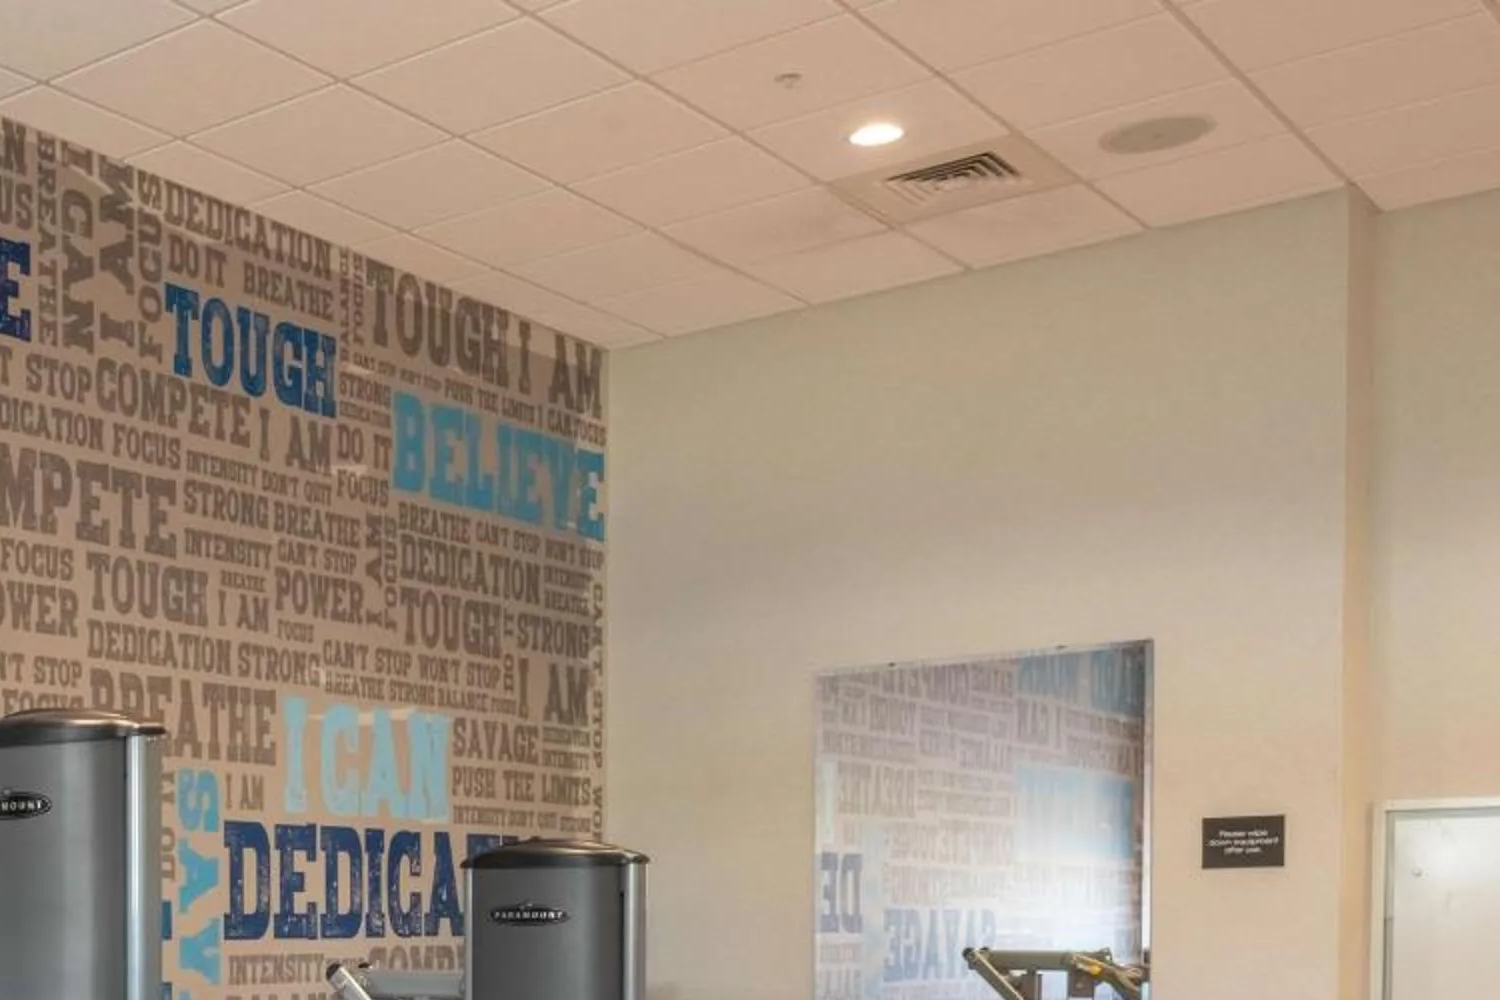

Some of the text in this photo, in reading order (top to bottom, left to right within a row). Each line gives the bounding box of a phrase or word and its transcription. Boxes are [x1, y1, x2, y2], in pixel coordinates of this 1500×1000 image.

[99, 153, 135, 295] AM
[163, 179, 333, 282] DEDICATION
[62, 188, 95, 354] CAN
[137, 170, 163, 365] FOCUS
[167, 233, 335, 323] DO IT BREATHE
[164, 281, 337, 419] TOUGH
[365, 257, 510, 388] TOUGH
[518, 319, 532, 396] I
[548, 332, 603, 421] AM
[25, 353, 93, 405] STOP
[96, 356, 251, 449] COMPETE
[259, 405, 272, 462] I
[285, 415, 333, 477] AM
[112, 423, 181, 470] FOCUS
[186, 449, 259, 486] INTENSITY
[336, 423, 393, 471] DO IT
[392, 390, 605, 542] BELIEVE
[182, 479, 361, 550] STRONG BREATHE
[336, 468, 390, 508] FOCUS
[397, 501, 472, 545] BREATHE
[1, 538, 74, 581] FOCUS
[184, 527, 357, 576] INTENSITY CAN'T STOP
[400, 533, 542, 605] DEDICATION
[85, 551, 209, 629] TOUGH
[218, 589, 270, 634] I AM
[275, 565, 365, 625] POWER
[399, 585, 502, 659] TOUGH
[516, 612, 590, 660] STRONG
[33, 655, 83, 688] STOP
[86, 617, 322, 689] DEDICATION STRONG
[323, 638, 501, 690] CAN'T STOP WON'T STOP
[325, 670, 385, 701] BREATHE
[518, 657, 590, 726] I AM
[282, 695, 308, 813] I
[320, 704, 450, 824] CAN
[451, 716, 540, 766] SAVAGE
[239, 774, 265, 812] AM
[452, 766, 496, 800] PUSH
[502, 768, 536, 802] THE
[228, 953, 325, 986] INTENSITY
